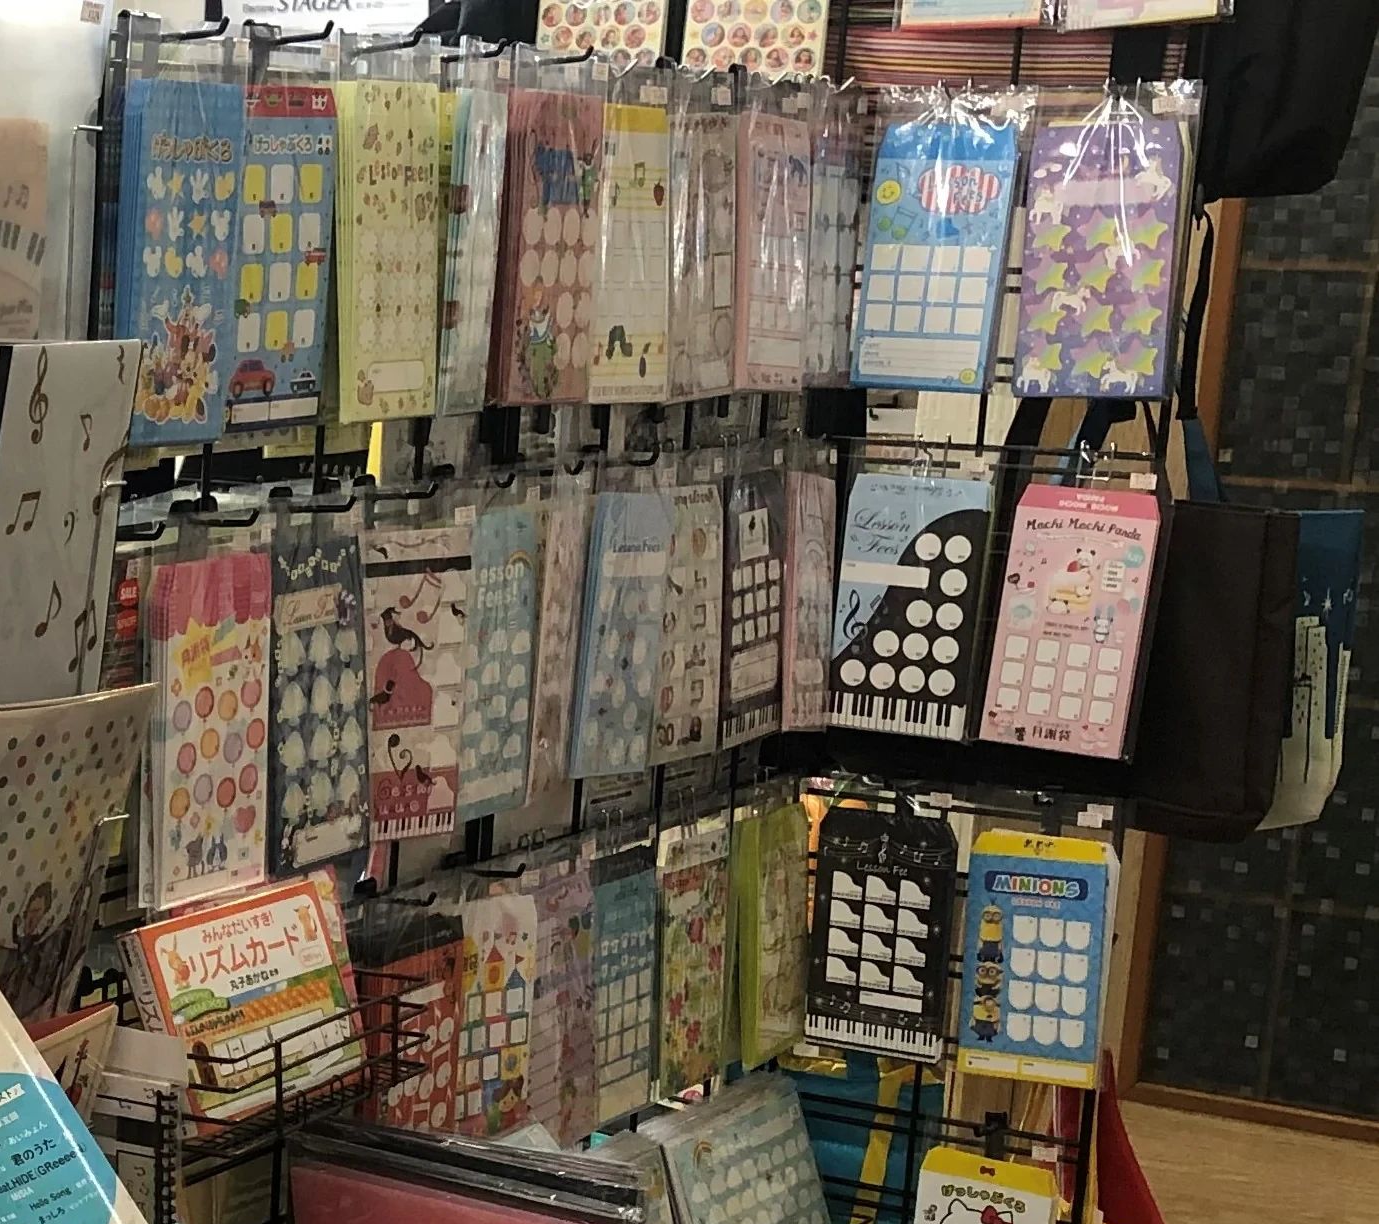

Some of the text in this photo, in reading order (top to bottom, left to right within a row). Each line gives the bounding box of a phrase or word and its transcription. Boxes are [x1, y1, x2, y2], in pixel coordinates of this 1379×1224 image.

[252, 134, 312, 154] げっしゃぶくろ
[368, 161, 403, 186] Lesson
[853, 508, 911, 533] Lesson
[1026, 518, 1141, 541] Mochi Mochi Panda
[858, 536, 900, 556] Fees
[1032, 725, 1071, 741] 月謝袋
[856, 861, 908, 875] Lesson Fee
[993, 875, 1080, 898] MINIONS
[202, 911, 275, 944] みんなだいすき!
[188, 926, 299, 985] リズムカード
[229, 970, 269, 992] 丸子あかね
[9, 1121, 47, 1145] あいみょん
[11, 1138, 57, 1167] 君のうた
[29, 1187, 72, 1211] Hello Song
[941, 1184, 1026, 1213] げっしゃぶくろ
[39, 1207, 66, 1224] まっしろ
